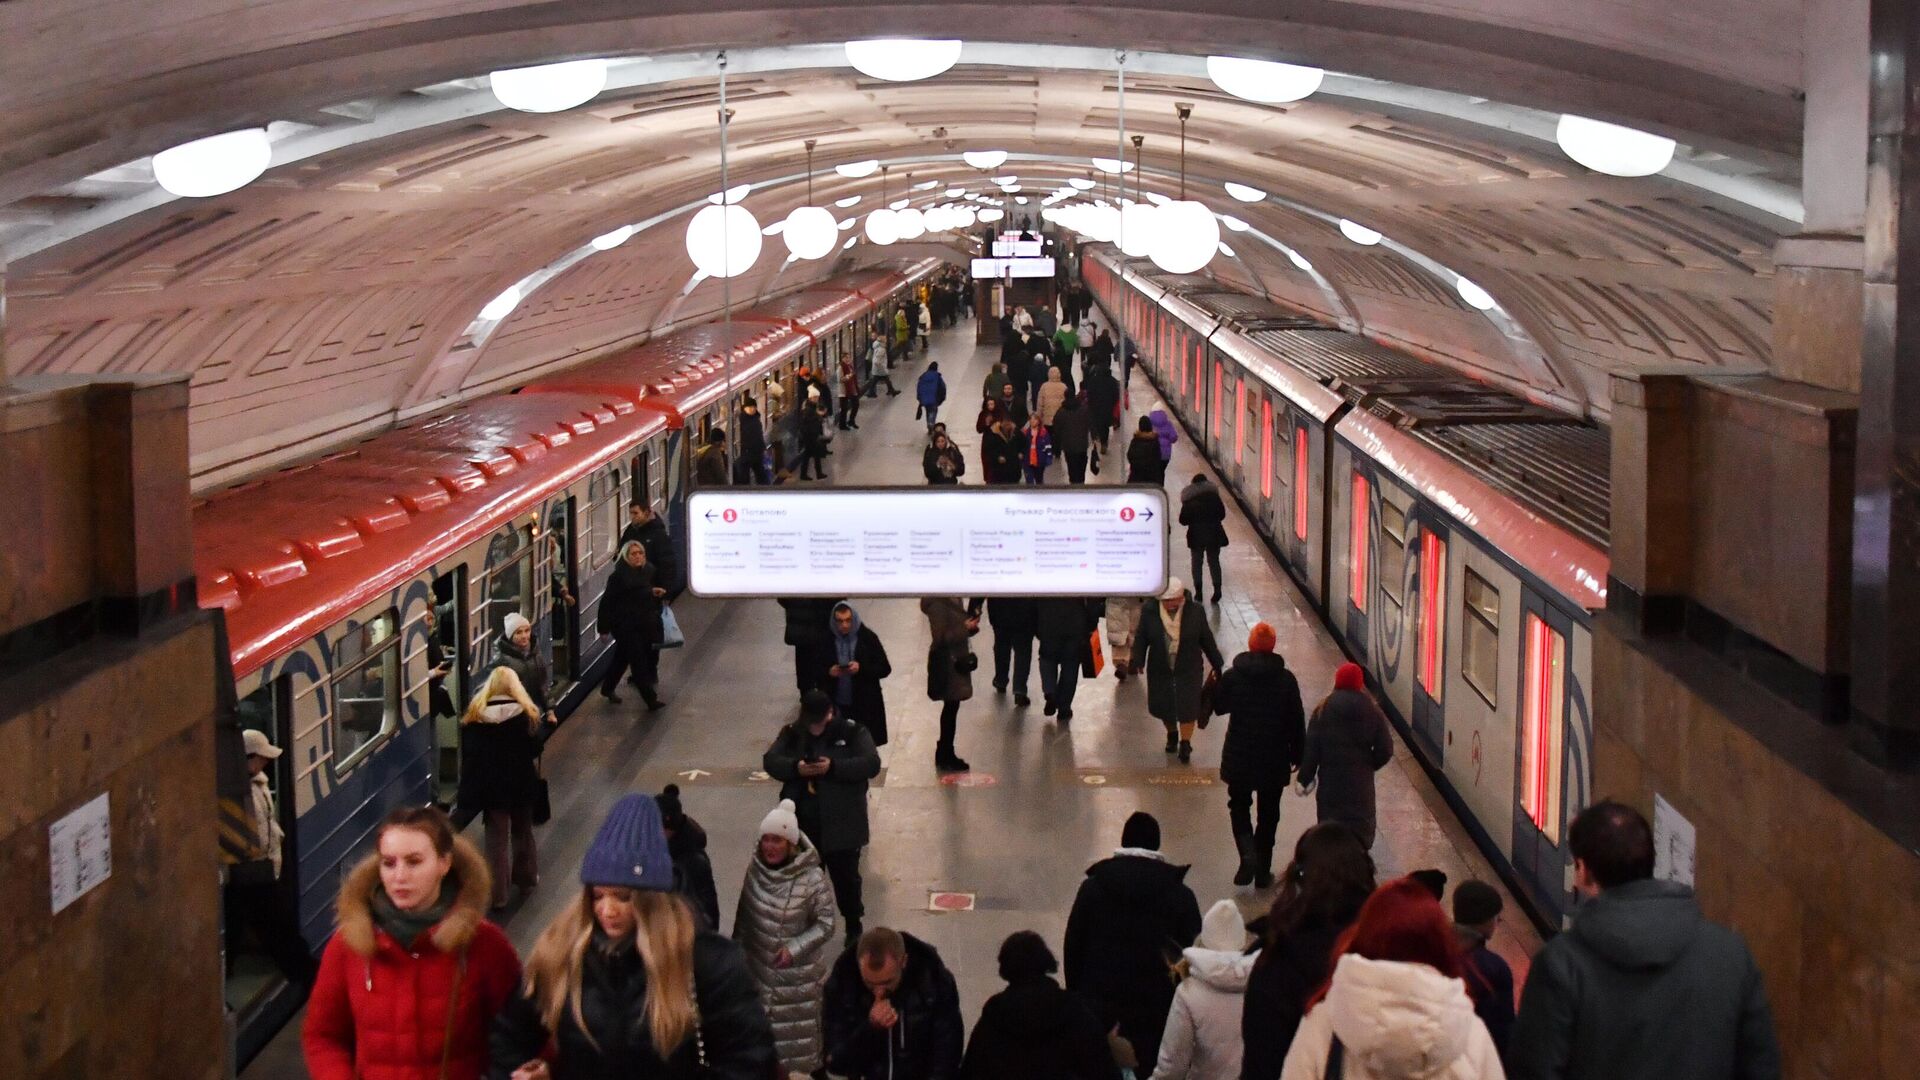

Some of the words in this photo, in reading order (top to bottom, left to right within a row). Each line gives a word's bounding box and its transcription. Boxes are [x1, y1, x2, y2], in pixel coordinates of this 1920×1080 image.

[741, 508, 788, 517] Потапово
[1004, 507, 1044, 517] Бульвар
[1046, 507, 1117, 516] Рокоссовского
